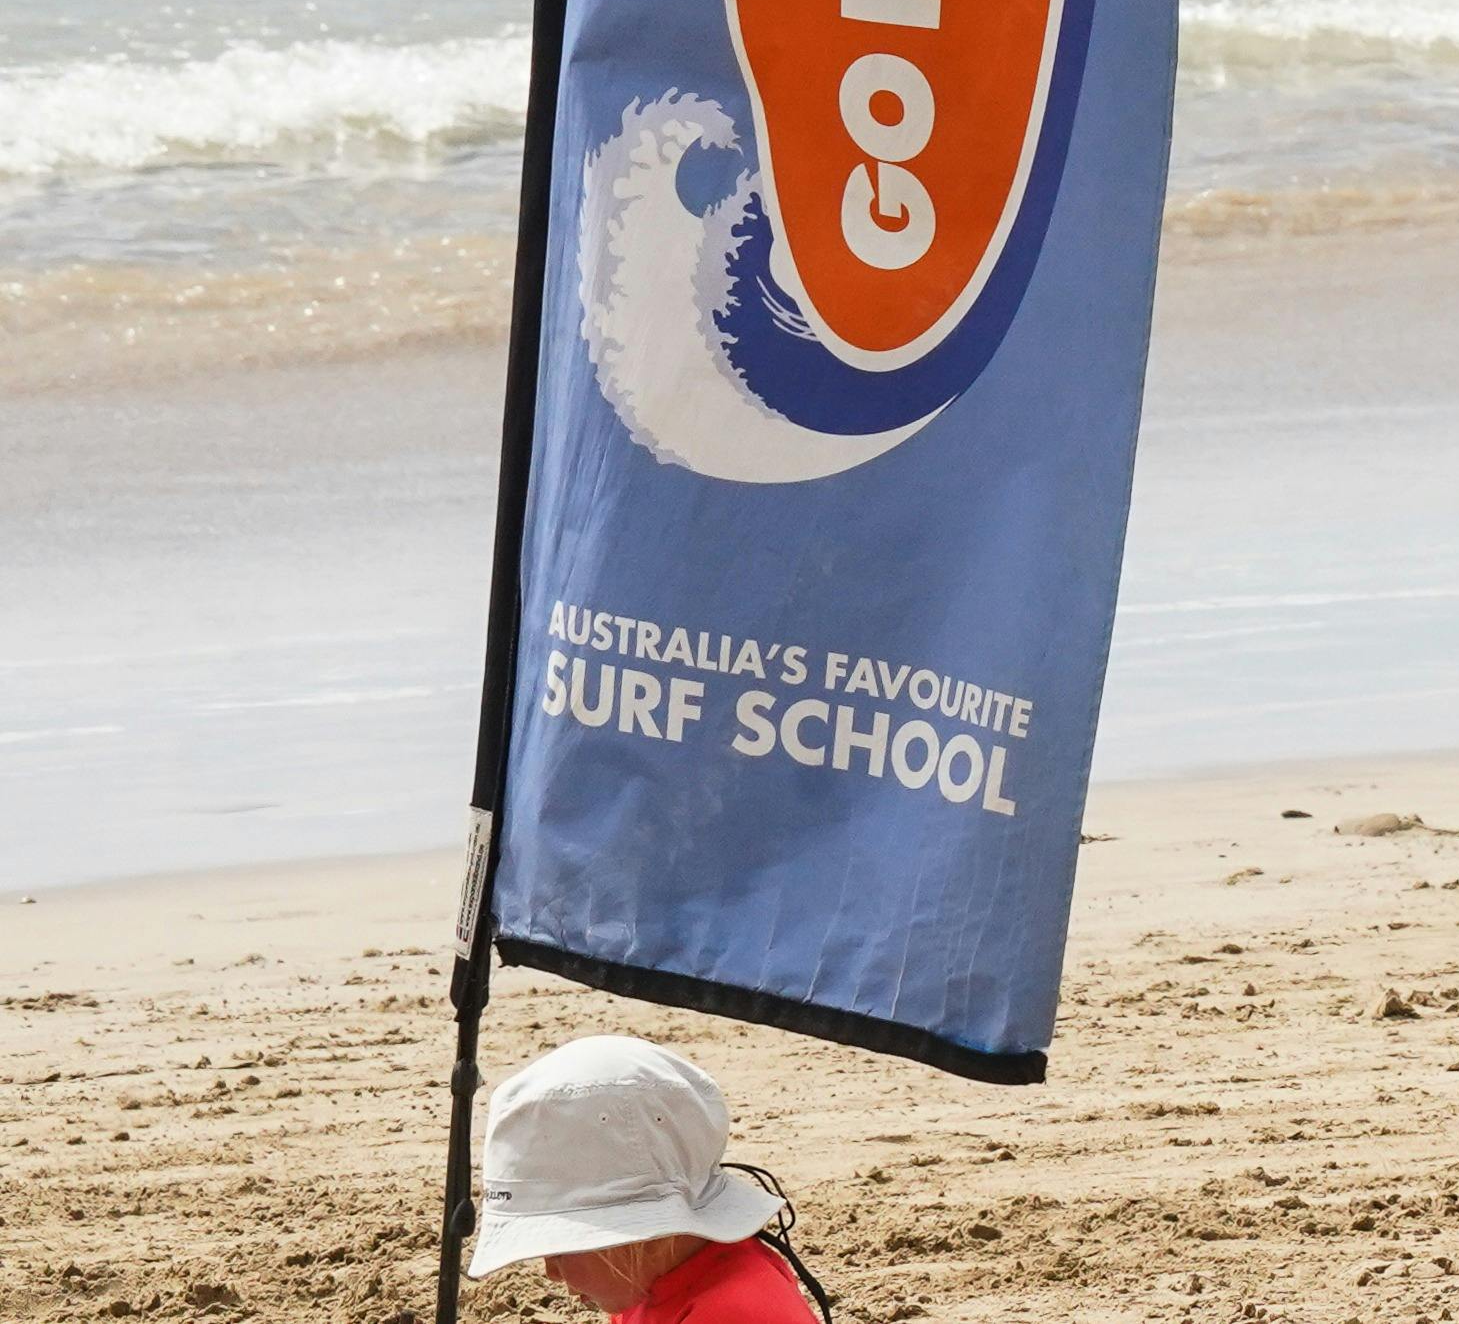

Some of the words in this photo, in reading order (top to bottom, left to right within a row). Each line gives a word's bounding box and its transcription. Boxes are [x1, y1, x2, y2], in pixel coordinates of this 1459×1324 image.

[837, 53, 937, 271] GO
[541, 649, 705, 743] SURF
[731, 689, 1017, 817] SCHOOL
[548, 600, 808, 686] AUSTRALIA'S
[824, 651, 1034, 739] FAVOURITE
